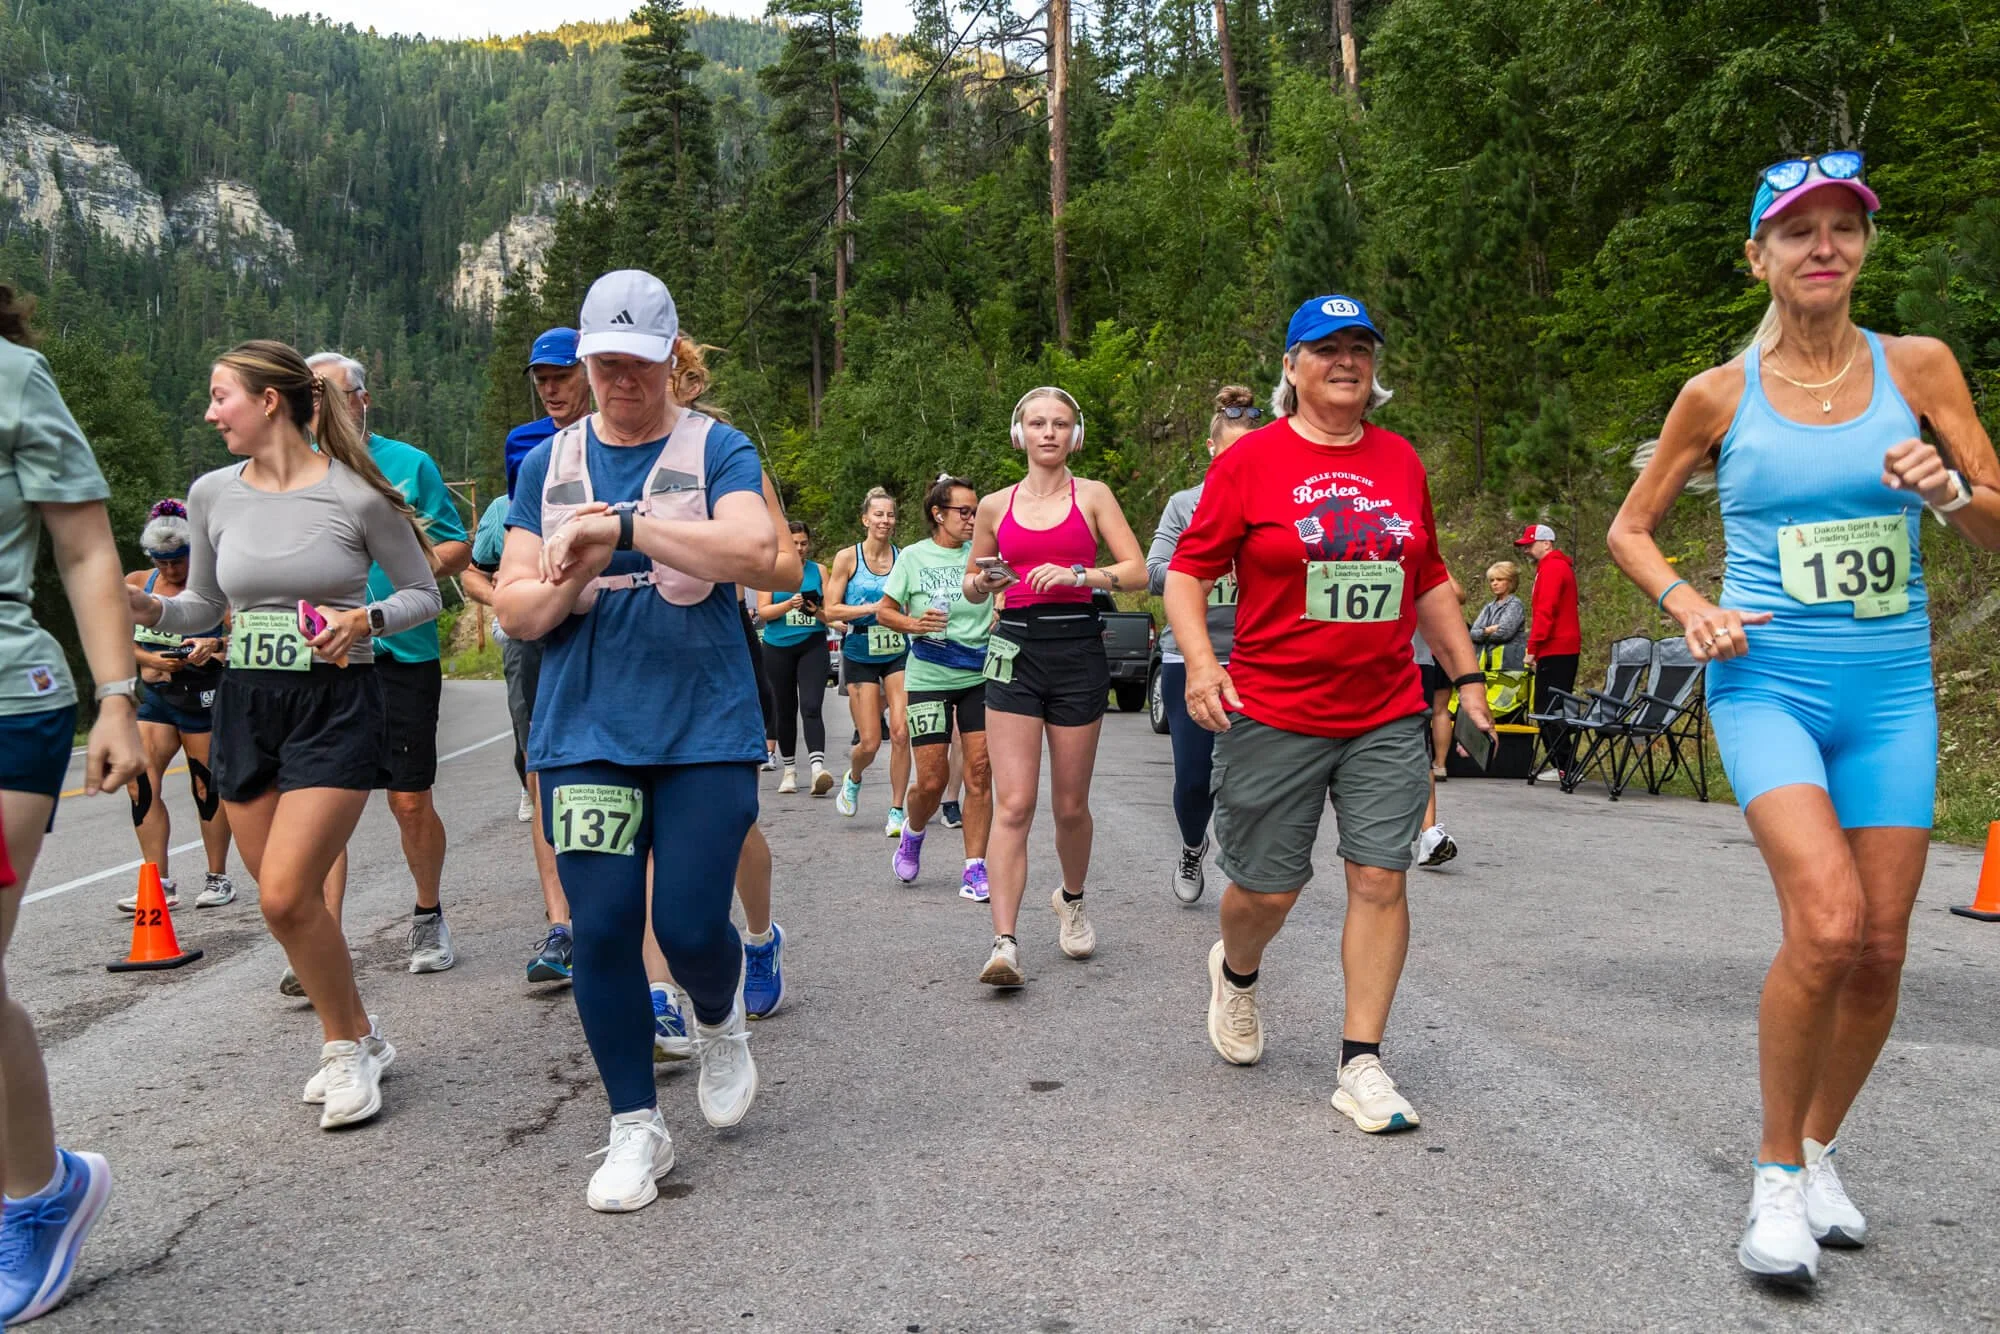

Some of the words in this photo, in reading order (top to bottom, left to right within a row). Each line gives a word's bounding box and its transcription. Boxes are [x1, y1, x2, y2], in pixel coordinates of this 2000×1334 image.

[1328, 302, 1356, 313] 13.1
[1304, 472, 1331, 486] BELLE
[1332, 472, 1374, 487] FOURCHE
[1293, 483, 1360, 504] Rodeo
[1353, 496, 1392, 512] Run
[1814, 526, 1845, 535] Dakota
[1848, 523, 1870, 533] Spirit
[1814, 534, 1849, 544] Leading
[1851, 530, 1880, 539] Ladies
[1803, 546, 1895, 599] 139
[1214, 582, 1239, 603] 17
[1324, 583, 1392, 619] 167
[240, 633, 297, 667] 156
[874, 634, 900, 648] 113
[983, 651, 1003, 678] 71
[909, 713, 938, 735] 157
[597, 788, 615, 796] Spirit
[560, 808, 632, 850] 137
[136, 909, 162, 926] 22
